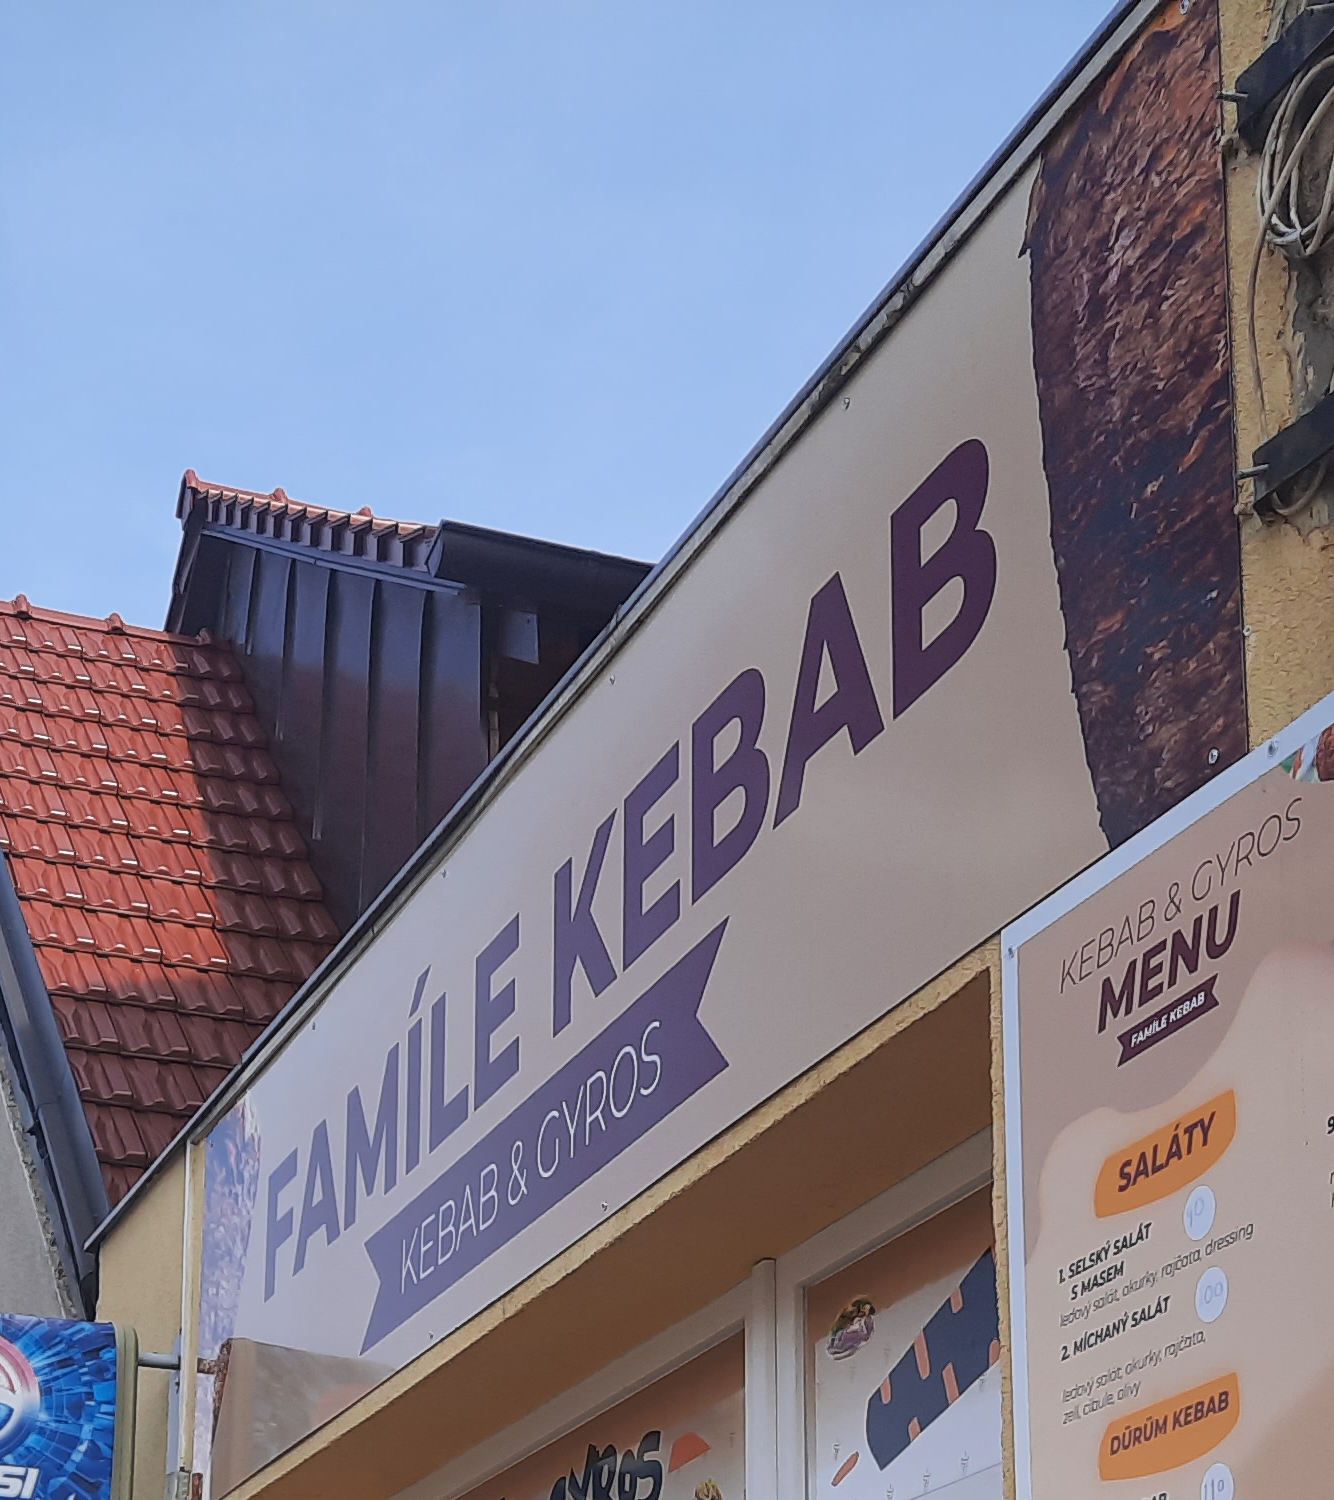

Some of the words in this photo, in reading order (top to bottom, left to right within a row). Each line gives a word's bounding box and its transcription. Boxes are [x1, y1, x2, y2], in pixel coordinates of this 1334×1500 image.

[264, 912, 520, 1303] FAMÍLE
[553, 438, 997, 1038] KEBAB
[1060, 900, 1156, 994] KEBAB
[1164, 882, 1182, 921] &
[1192, 798, 1302, 901] GYROS
[1098, 889, 1241, 1034] MENU
[1169, 992, 1205, 1023] KEBAB
[400, 1167, 499, 1293] KEBAB
[507, 1141, 529, 1205] &
[536, 1020, 663, 1180] GYROS
[1118, 1111, 1216, 1192] SALÁTY
[1068, 1241, 1111, 1279] SELSKÝ
[1113, 1222, 1152, 1256] SALÁT
[1205, 1223, 1254, 1256] dressing
[1081, 1261, 1124, 1296] MASEM
[1073, 1312, 1129, 1356] MÍCHANÝ
[1131, 1296, 1171, 1327] SALÁT
[1110, 1415, 1167, 1456] DÜRÜM
[1172, 1391, 1229, 1431] KEBAB
